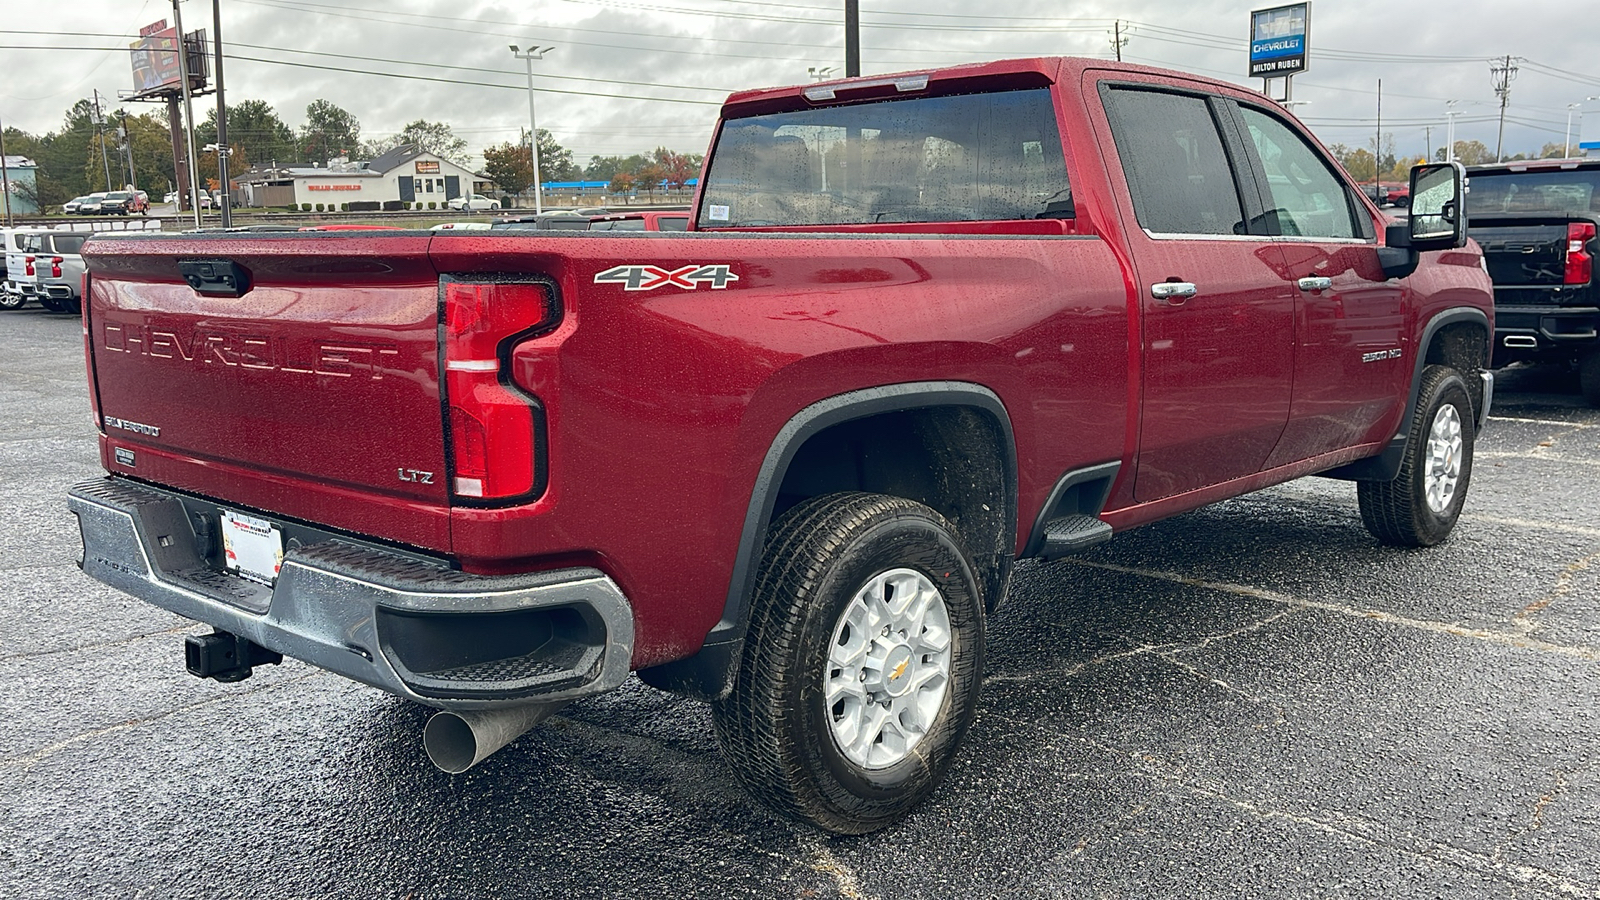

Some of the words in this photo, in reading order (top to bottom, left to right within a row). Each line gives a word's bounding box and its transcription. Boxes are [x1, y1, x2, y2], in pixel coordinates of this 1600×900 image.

[1253, 39, 1300, 53] CHEVROLET
[1253, 62, 1276, 73] MILTON
[1278, 59, 1301, 69] RUBEN
[594, 264, 740, 291] 4X4
[103, 321, 399, 380] CHEVROLET
[1388, 348, 1402, 359] HD
[104, 415, 161, 437] SILVERADO
[397, 467, 435, 485] LTZ
